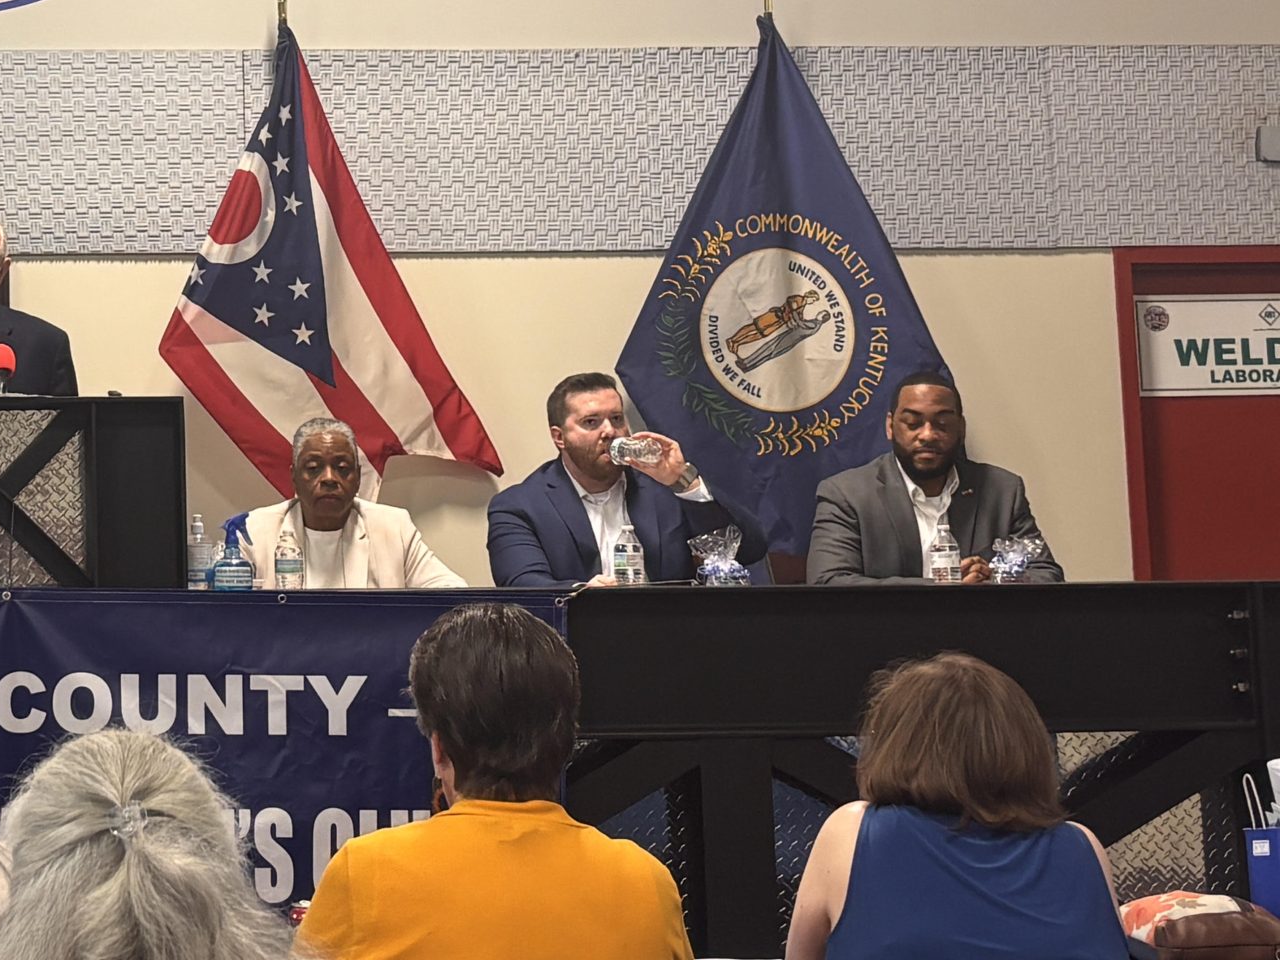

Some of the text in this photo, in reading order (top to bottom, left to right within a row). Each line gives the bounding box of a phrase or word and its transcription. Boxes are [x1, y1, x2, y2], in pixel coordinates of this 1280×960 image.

[735, 213, 889, 424] COMMONWEALTH OF KENTUCKY
[788, 260, 847, 353] UNITED WE STAND
[707, 314, 763, 399] DIVIDED WE FALL
